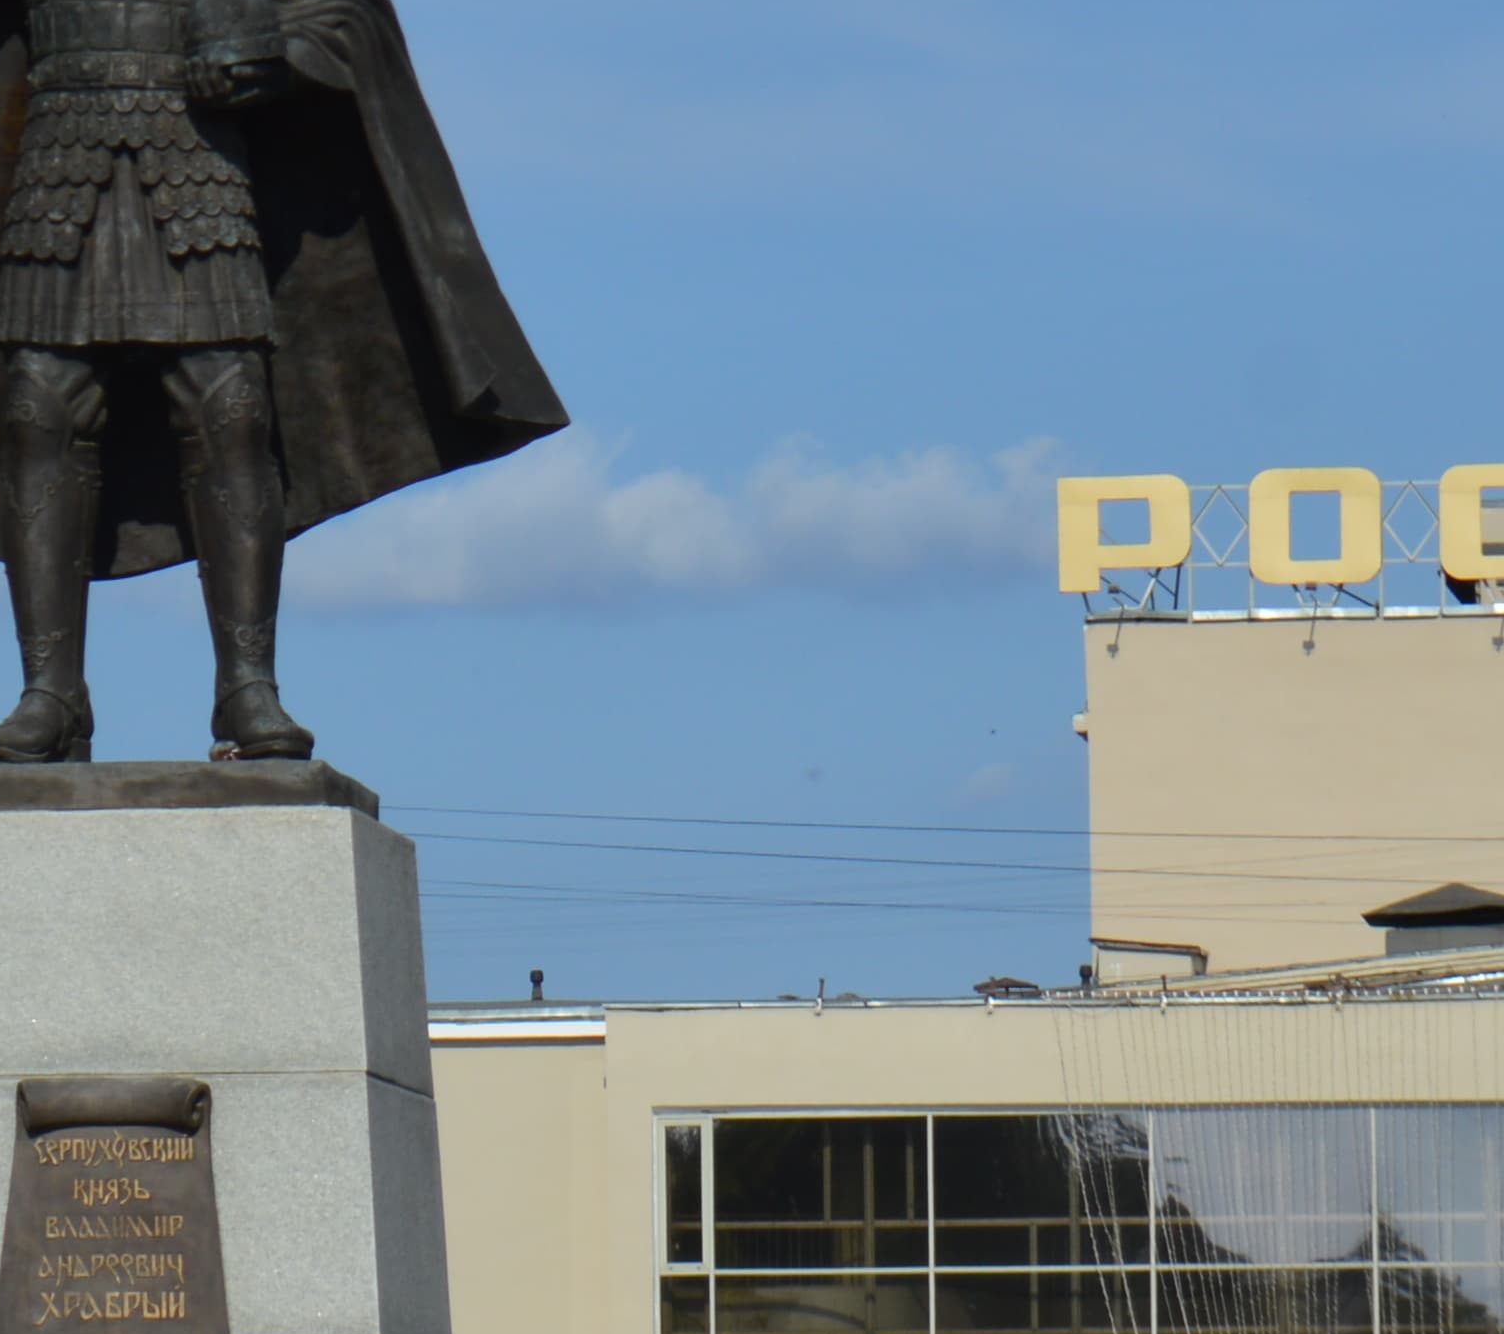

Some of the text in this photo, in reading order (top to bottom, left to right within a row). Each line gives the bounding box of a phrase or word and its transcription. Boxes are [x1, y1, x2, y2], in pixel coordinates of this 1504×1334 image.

[34, 1129, 193, 1167] СЕРПУХОВСКИЙ
[73, 1177, 151, 1206] КНЯЗЬ
[46, 1215, 183, 1238] ВЛАДИМИР
[38, 1253, 184, 1286] АНДРЕЕВИЧ
[34, 1284, 185, 1325] ХРАБРЫЙ
